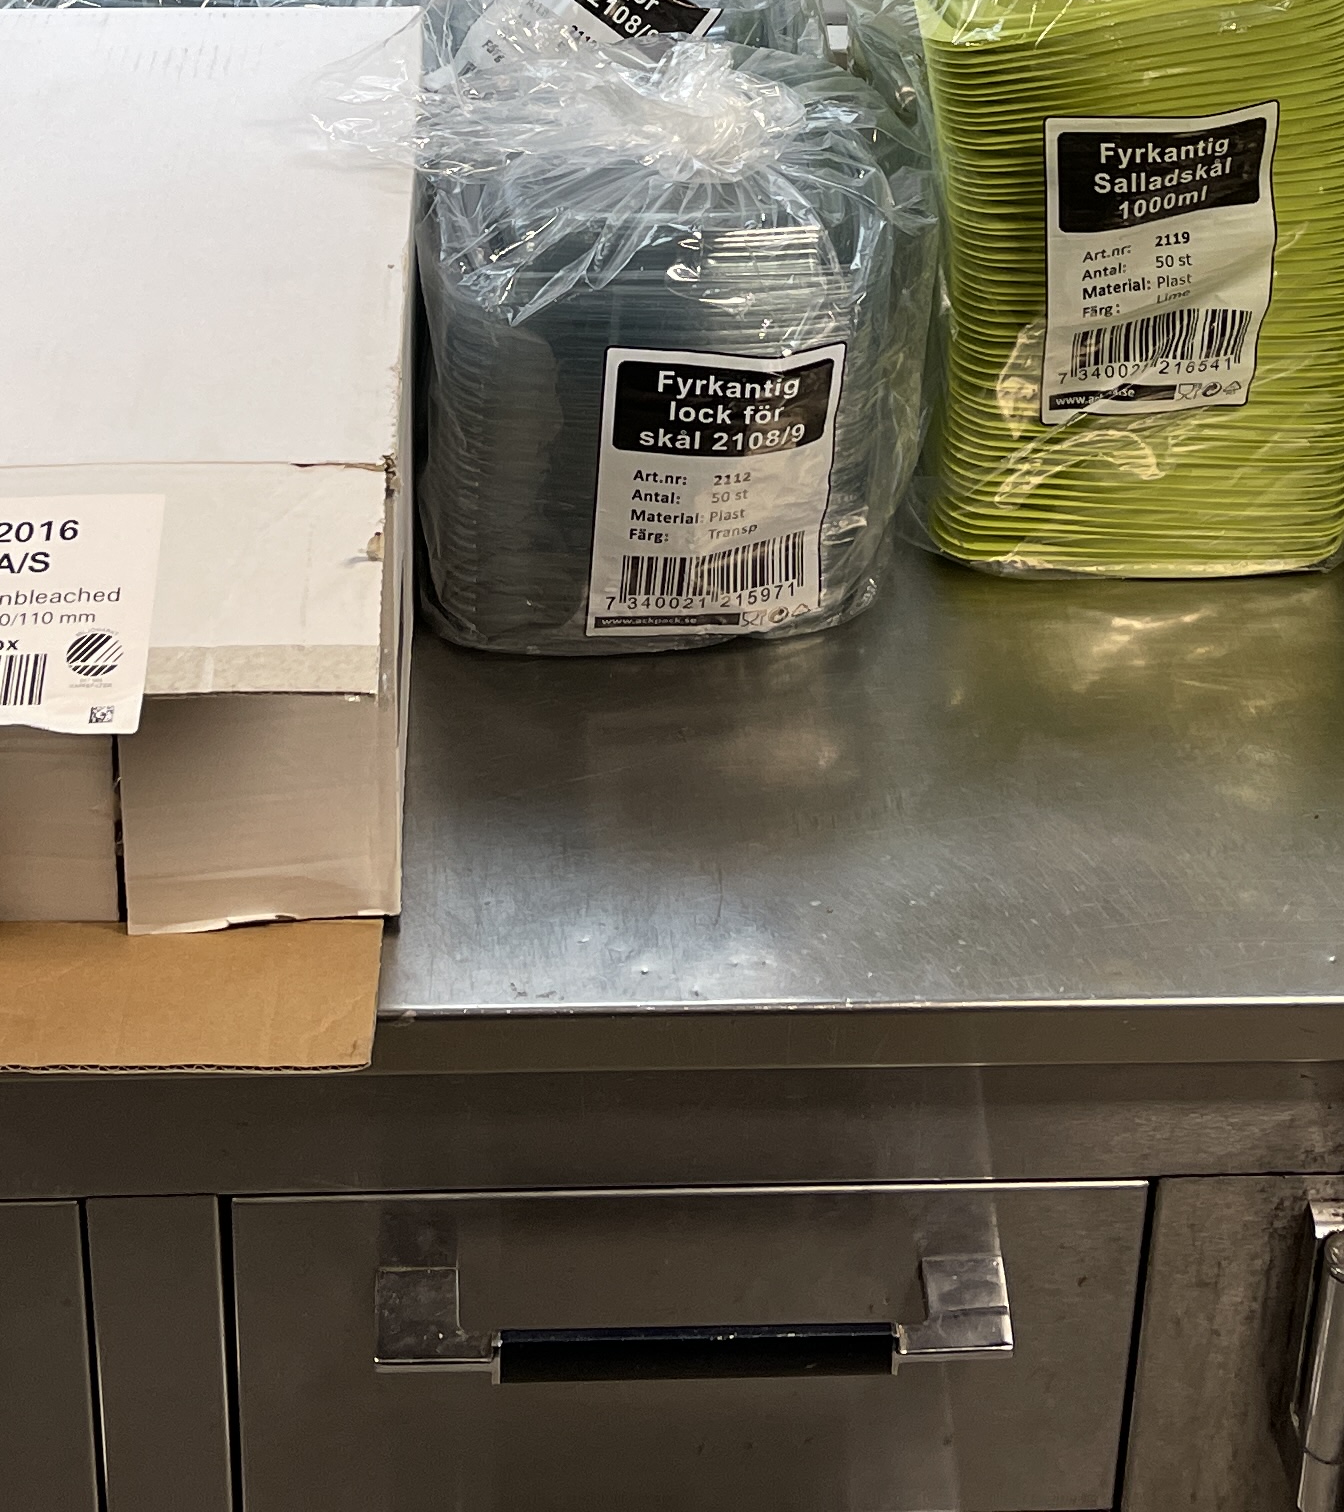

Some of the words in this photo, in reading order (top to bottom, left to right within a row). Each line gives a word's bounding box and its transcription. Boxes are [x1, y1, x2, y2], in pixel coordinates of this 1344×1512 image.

[1099, 137, 1230, 170] Fyrkantig
[1093, 157, 1233, 195] Salladskål
[1118, 185, 1208, 221] 1000ml
[1082, 244, 1132, 264] Art.nr:
[1154, 231, 1191, 248] 2119
[1081, 262, 1127, 282] Antal:
[1155, 256, 1174, 270] 50
[1177, 254, 1193, 267] st
[1082, 277, 1151, 301] Material:
[1156, 273, 1193, 289] Plast
[657, 370, 800, 400] Fyrkantig
[1058, 372, 1068, 385] 7
[1158, 357, 1234, 375] 216541
[669, 401, 732, 425] lock
[743, 403, 784, 425] för
[639, 428, 701, 450] skål
[711, 423, 806, 451] 2108/9
[633, 469, 687, 486] Art.nr:
[713, 471, 752, 486] 2112
[631, 489, 681, 505] Antal:
[711, 491, 731, 504] 50
[734, 489, 749, 502] st
[630, 509, 705, 525] Material:
[709, 508, 746, 523] Plast
[629, 528, 669, 544] Färg:
[708, 523, 758, 540] Transp
[606, 596, 616, 610] 7
[627, 595, 708, 610] 340021
[719, 581, 796, 608] 215971
[59, 611, 96, 625] mm
